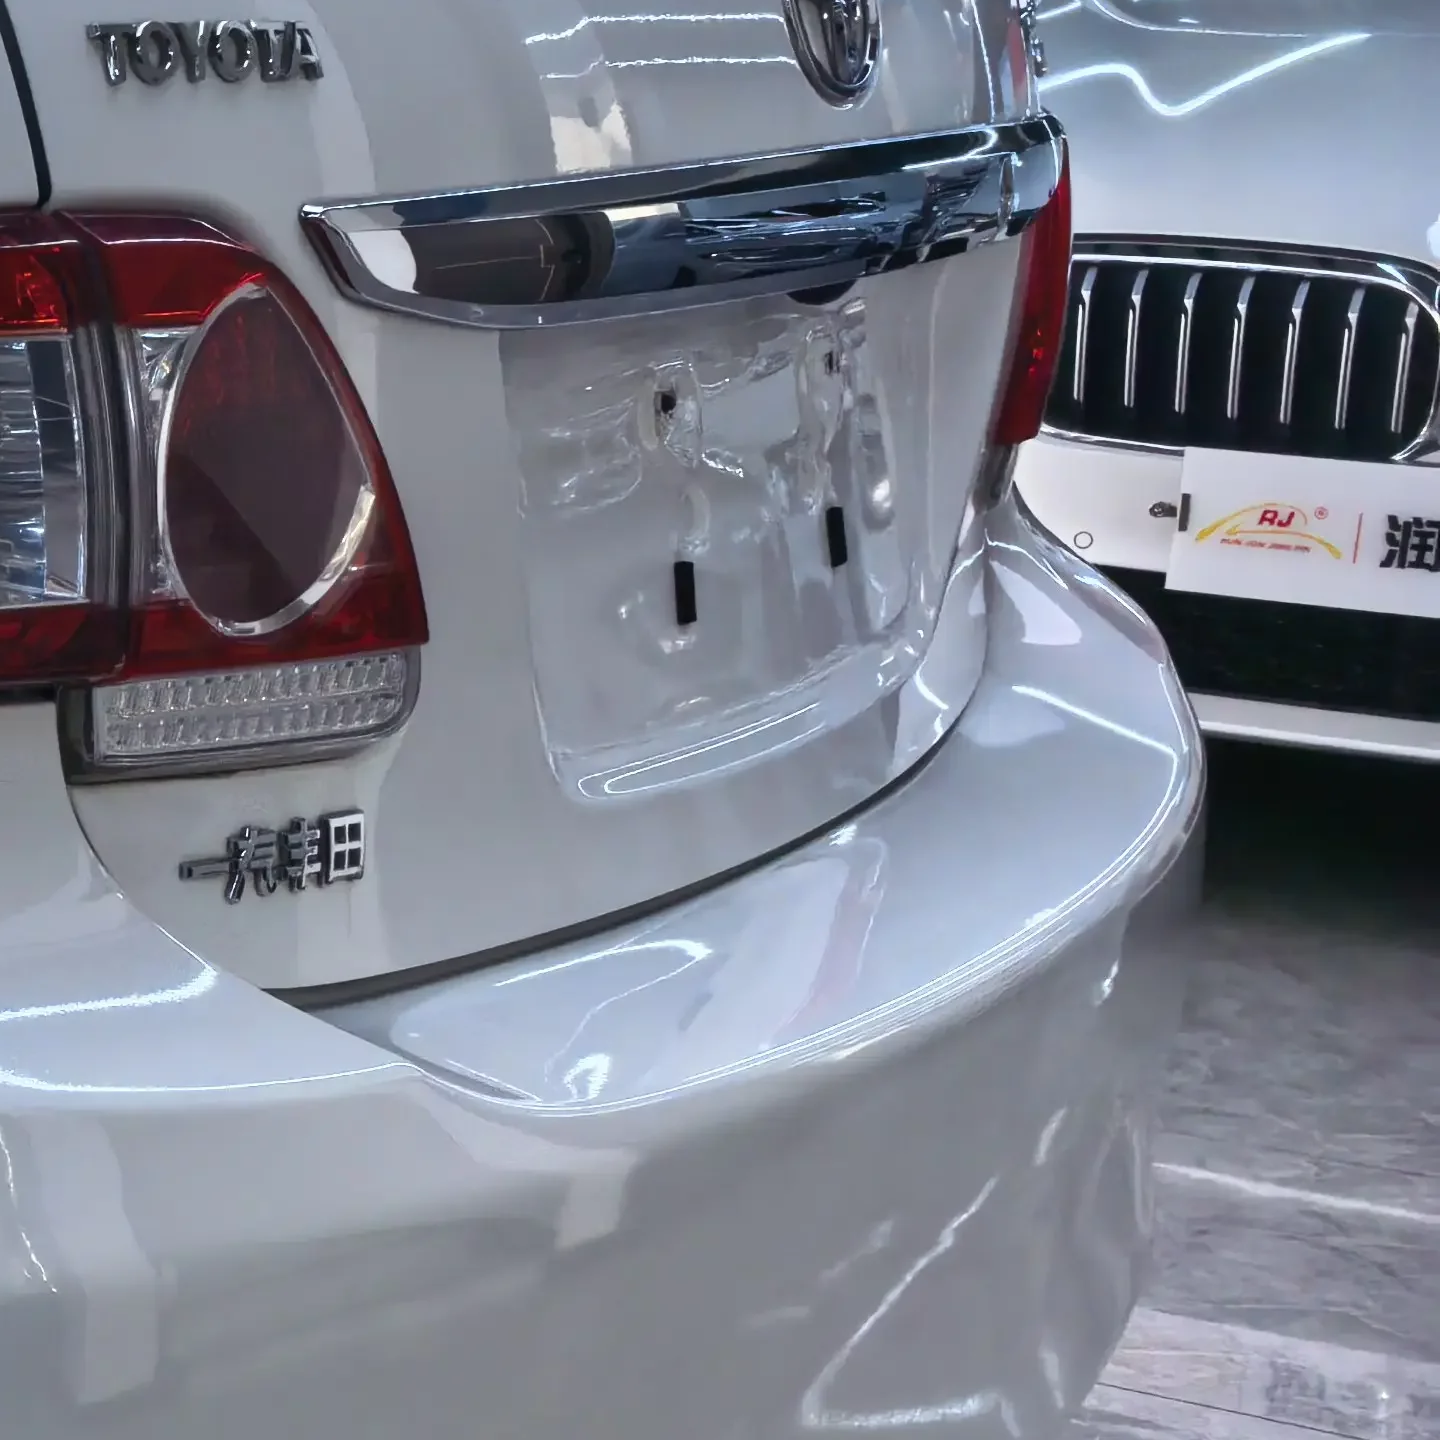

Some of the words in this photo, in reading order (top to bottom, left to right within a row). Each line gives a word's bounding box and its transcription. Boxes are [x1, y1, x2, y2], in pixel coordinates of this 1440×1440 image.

[84, 19, 325, 87] TOYOTA
[1257, 509, 1296, 528] RJ
[177, 805, 365, 905] 一汽丰田
